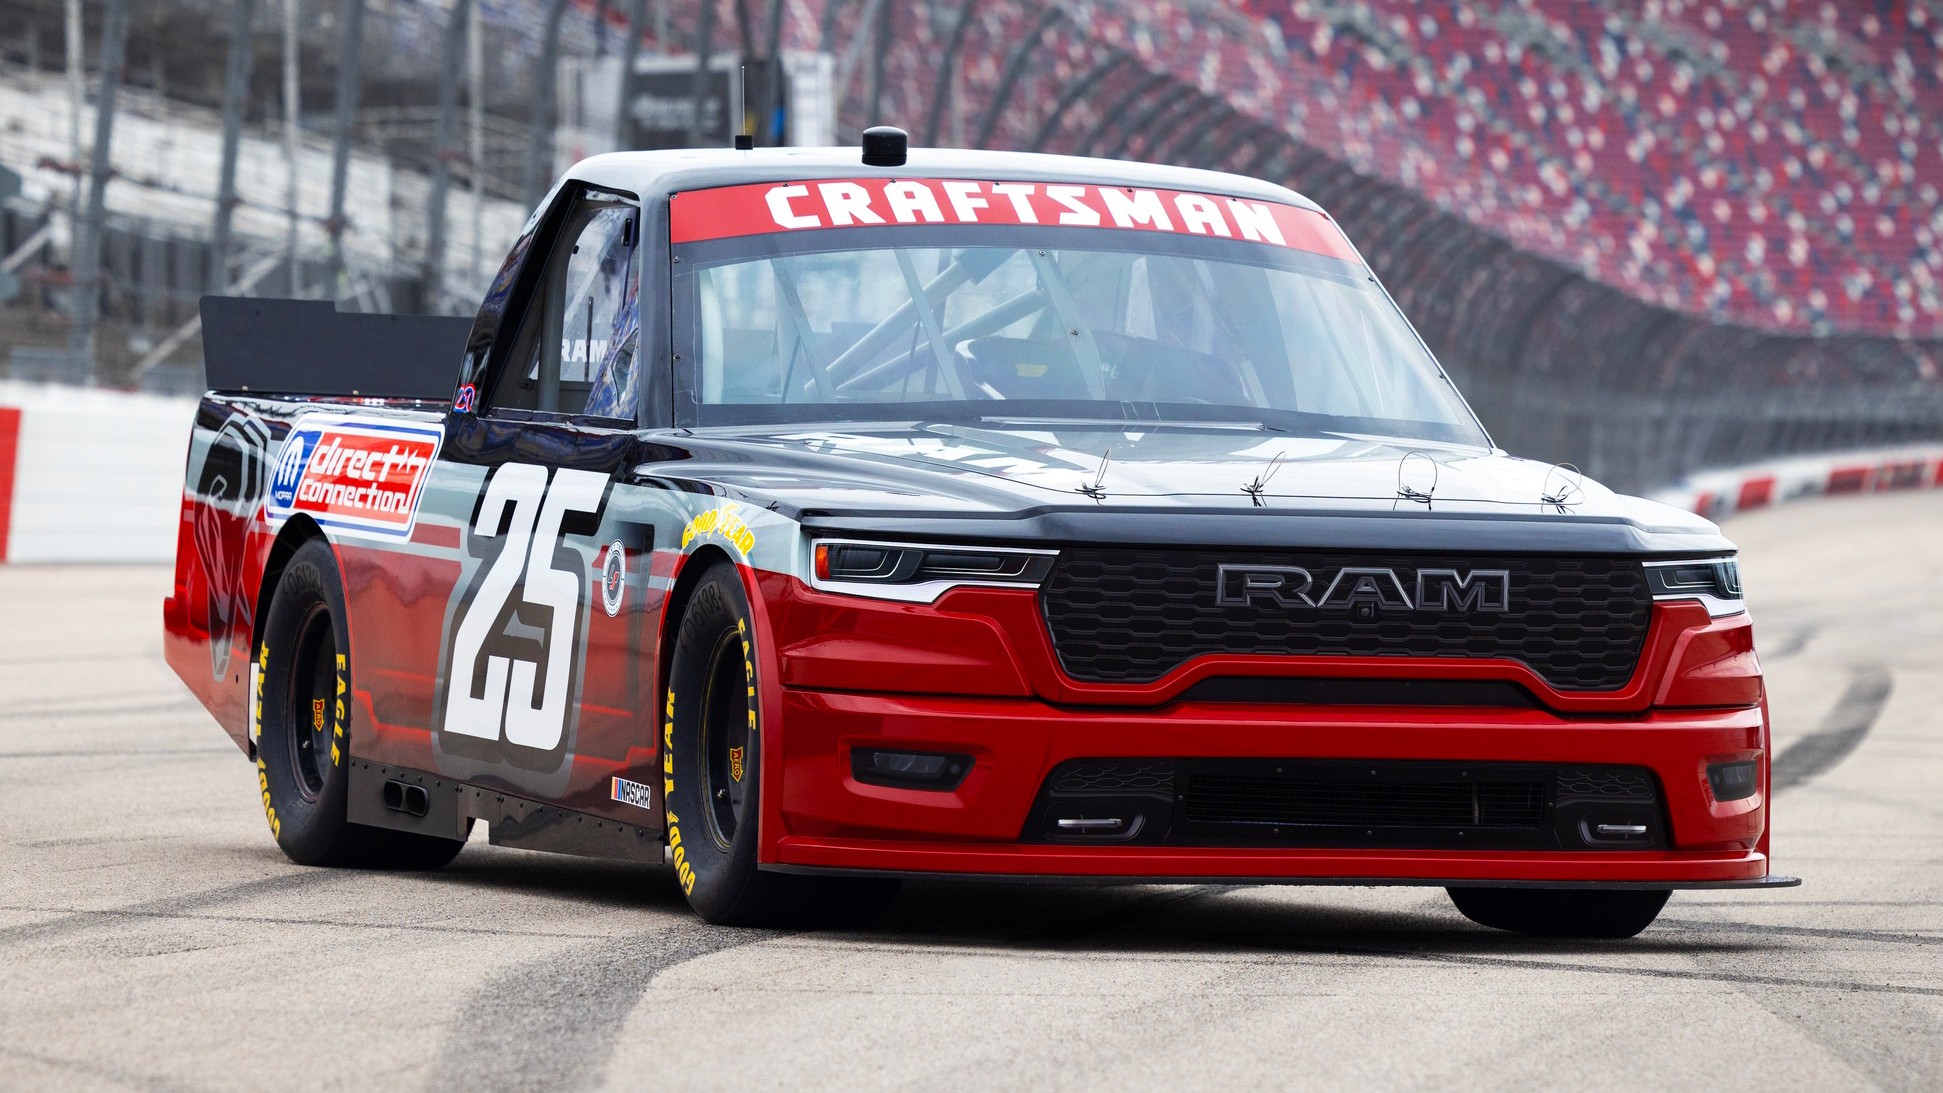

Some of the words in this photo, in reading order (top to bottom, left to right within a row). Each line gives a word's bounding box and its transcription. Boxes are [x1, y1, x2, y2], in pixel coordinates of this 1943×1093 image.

[765, 180, 1285, 246] CRAFTSMAN
[310, 437, 400, 482] direct
[299, 478, 413, 514] connection
[444, 462, 610, 750] 25
[1216, 564, 1509, 612] RAM
[738, 617, 756, 730] EAGLE
[331, 653, 346, 767] EAGLE
[621, 780, 650, 807] NASCAR
